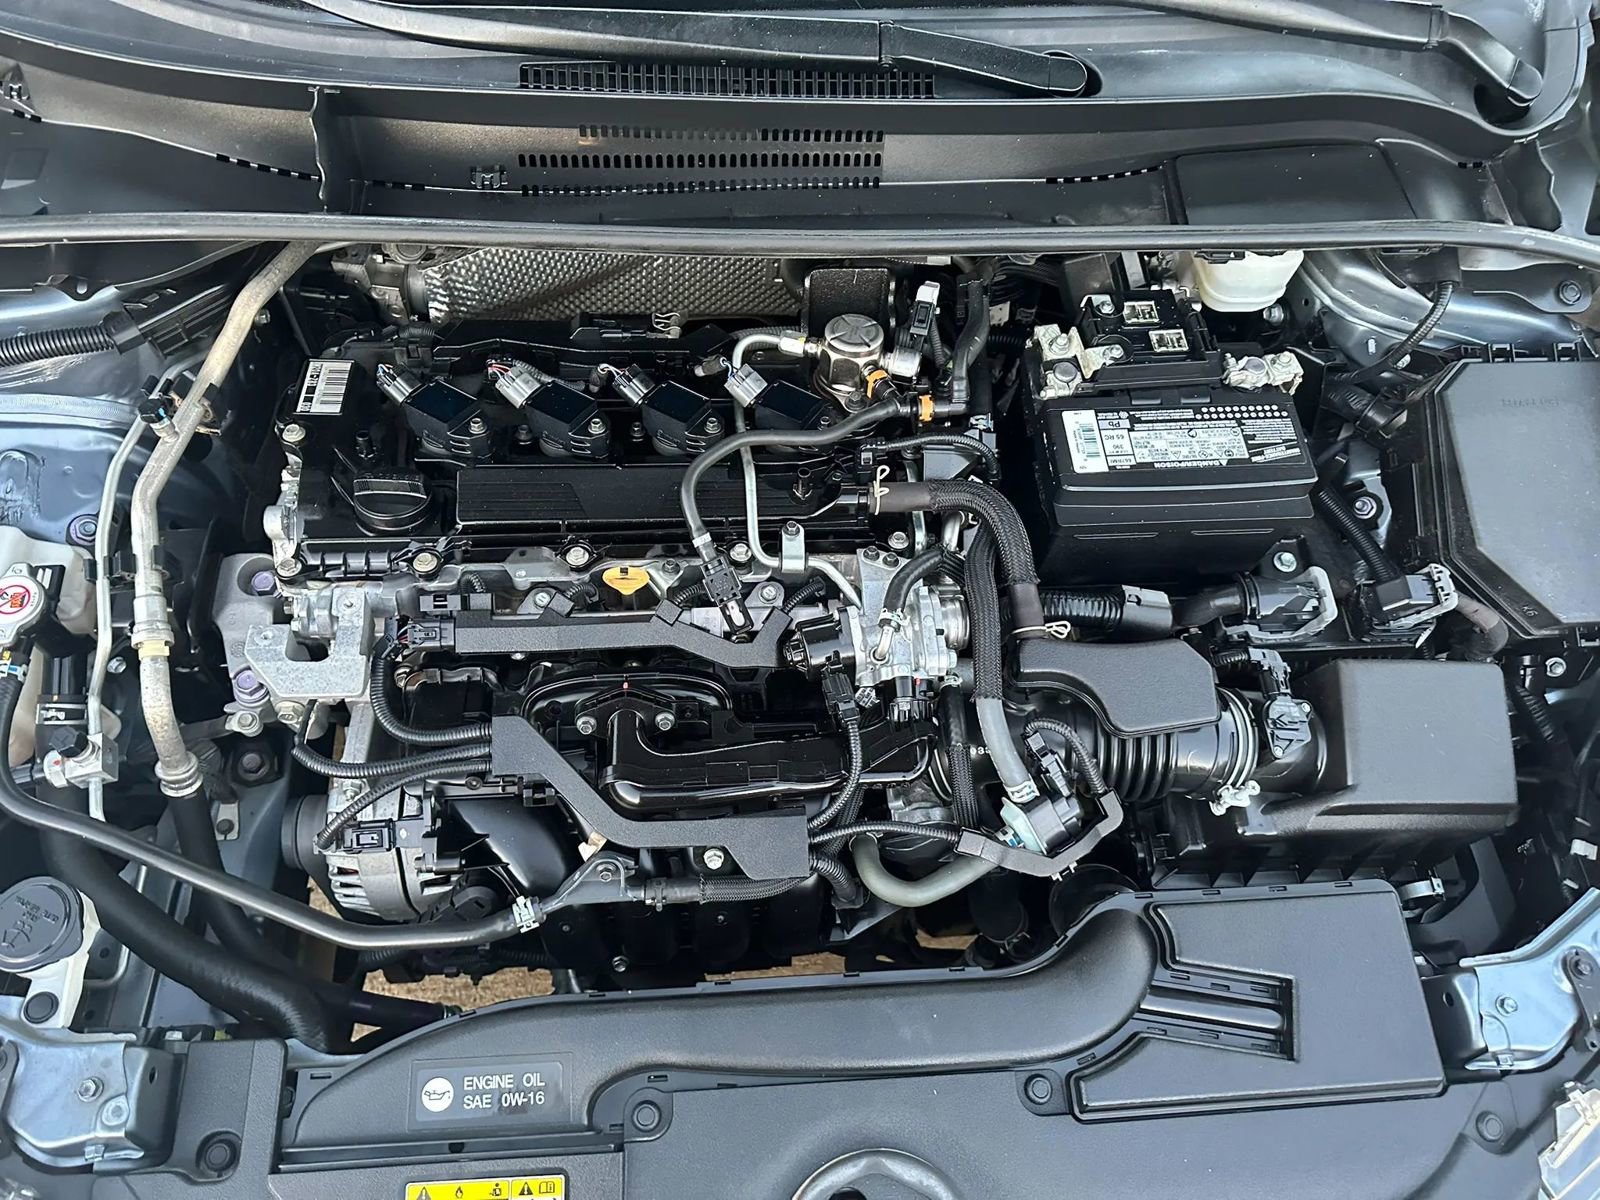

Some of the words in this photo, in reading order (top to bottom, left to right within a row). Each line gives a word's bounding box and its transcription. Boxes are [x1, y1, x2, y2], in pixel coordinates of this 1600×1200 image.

[463, 1074, 514, 1091] ENGINE
[522, 1073, 545, 1087] OIL
[463, 1094, 492, 1109] SAE
[501, 1092, 545, 1107] 0W-16
